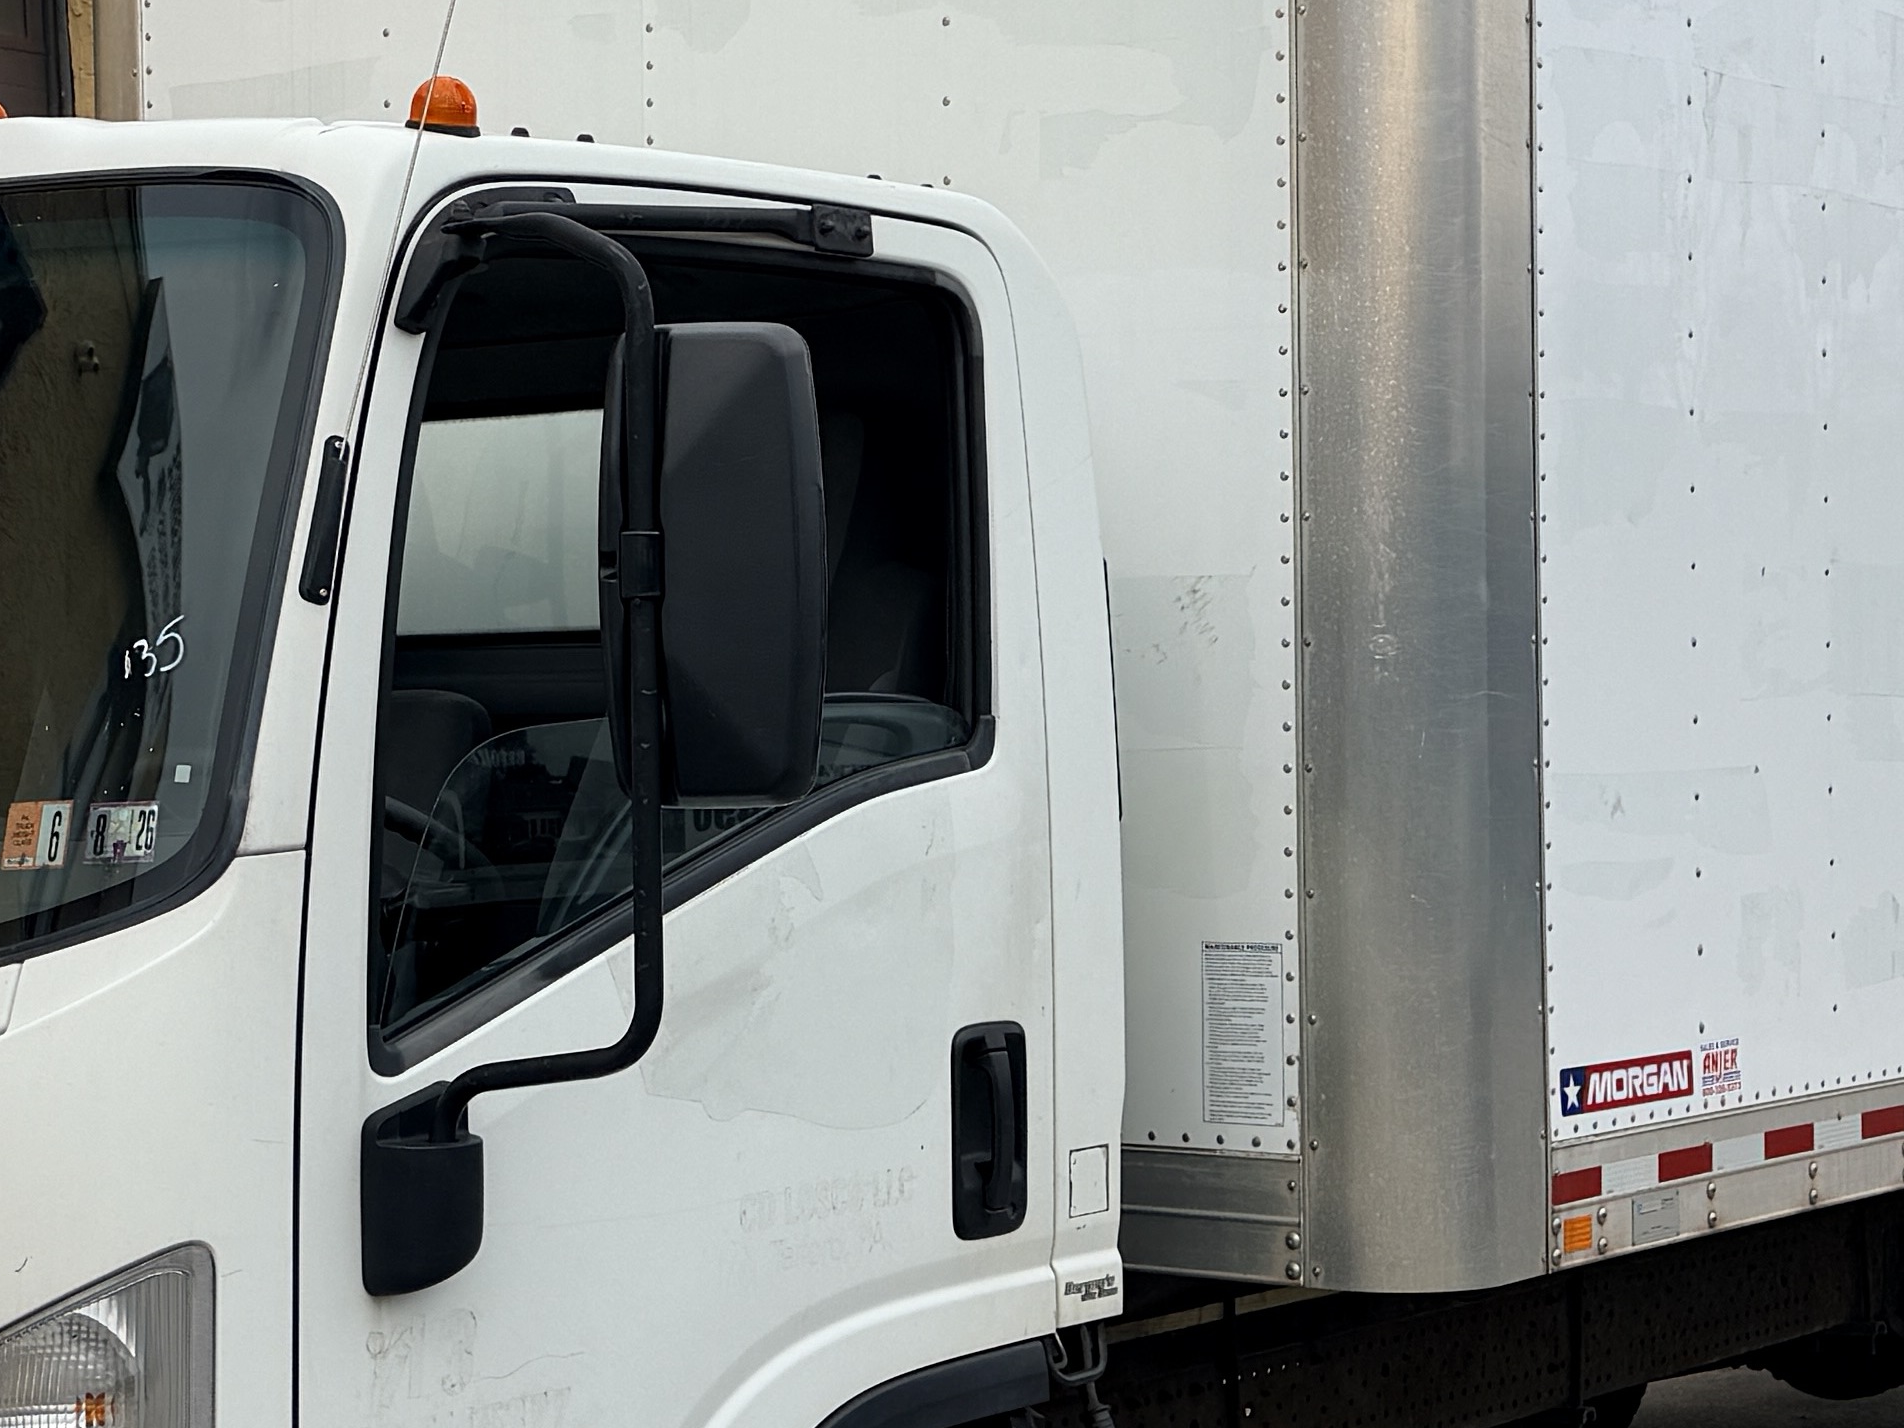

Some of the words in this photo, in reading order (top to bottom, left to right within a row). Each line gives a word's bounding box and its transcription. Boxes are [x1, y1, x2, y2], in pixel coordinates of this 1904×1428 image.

[124, 614, 185, 679] 135
[47, 810, 63, 862] 6
[135, 809, 156, 851] 26
[1587, 1059, 1689, 1106] MORGAN
